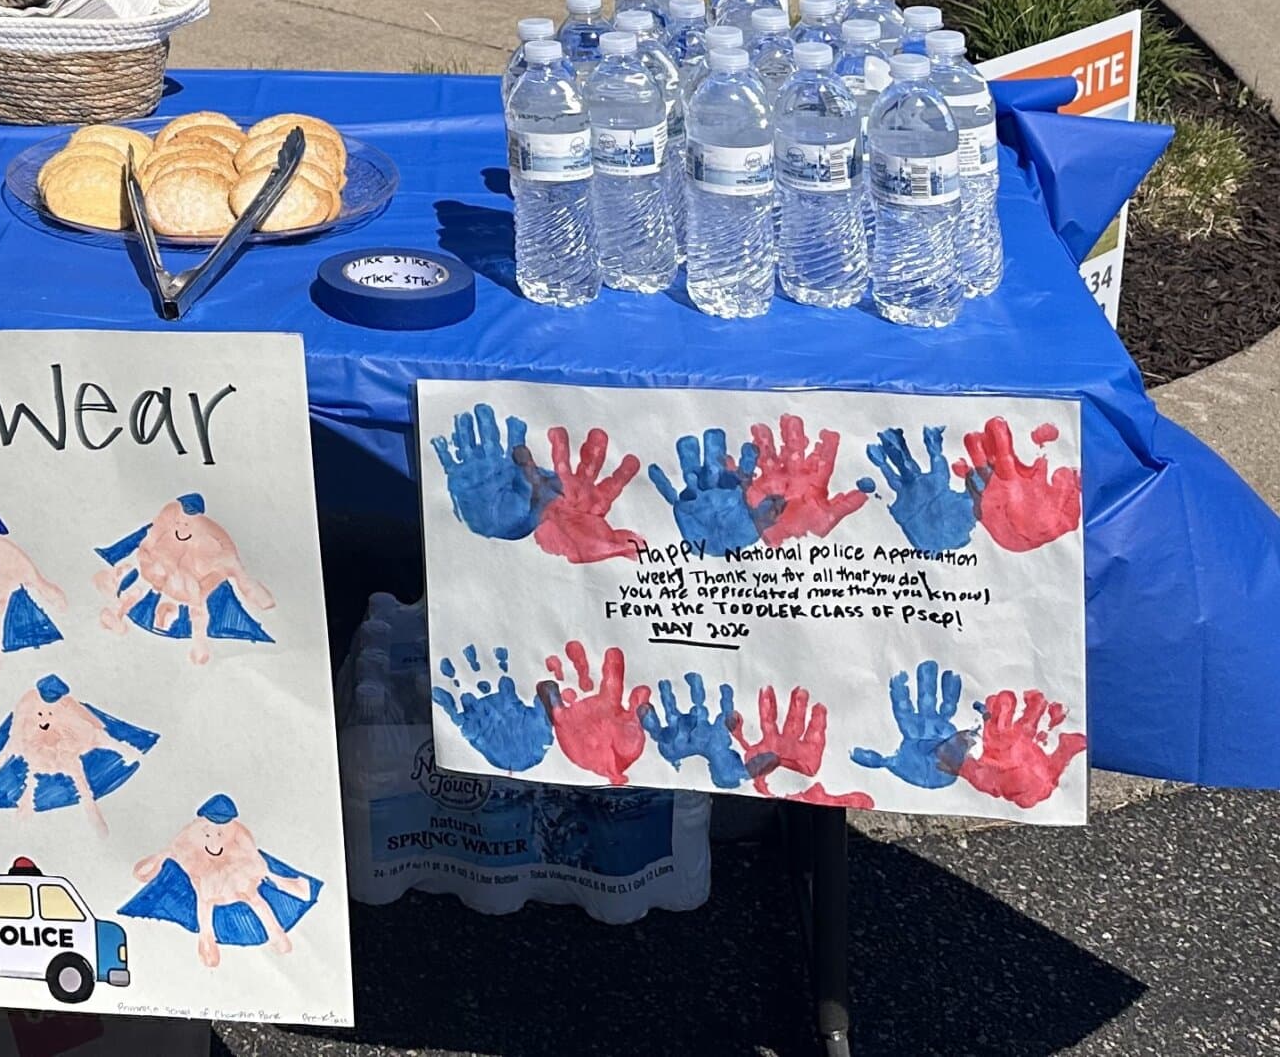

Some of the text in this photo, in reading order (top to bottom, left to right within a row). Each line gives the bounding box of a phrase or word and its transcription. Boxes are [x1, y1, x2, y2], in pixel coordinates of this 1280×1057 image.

[1073, 50, 1125, 101] SITE
[725, 543, 802, 563] National
[809, 543, 865, 565] police
[873, 545, 978, 566] Appreciation
[689, 570, 748, 585] Thank
[752, 571, 778, 587] you
[782, 567, 805, 583] for
[813, 568, 833, 583] all
[836, 566, 871, 582] that
[872, 571, 895, 587] you
[696, 586, 799, 600] appreciated
[807, 588, 846, 599] more
[846, 584, 887, 596] than
[892, 590, 922, 600] you
[606, 602, 663, 618] FROM
[671, 602, 705, 617] the
[712, 602, 808, 619] TODDLER
[810, 604, 864, 618] CLASS
[872, 605, 895, 618] OF
[652, 622, 750, 638] MAY 2026
[428, 773, 485, 797] Touch
[430, 816, 482, 837] natural
[387, 830, 528, 856] SPRING WATER
